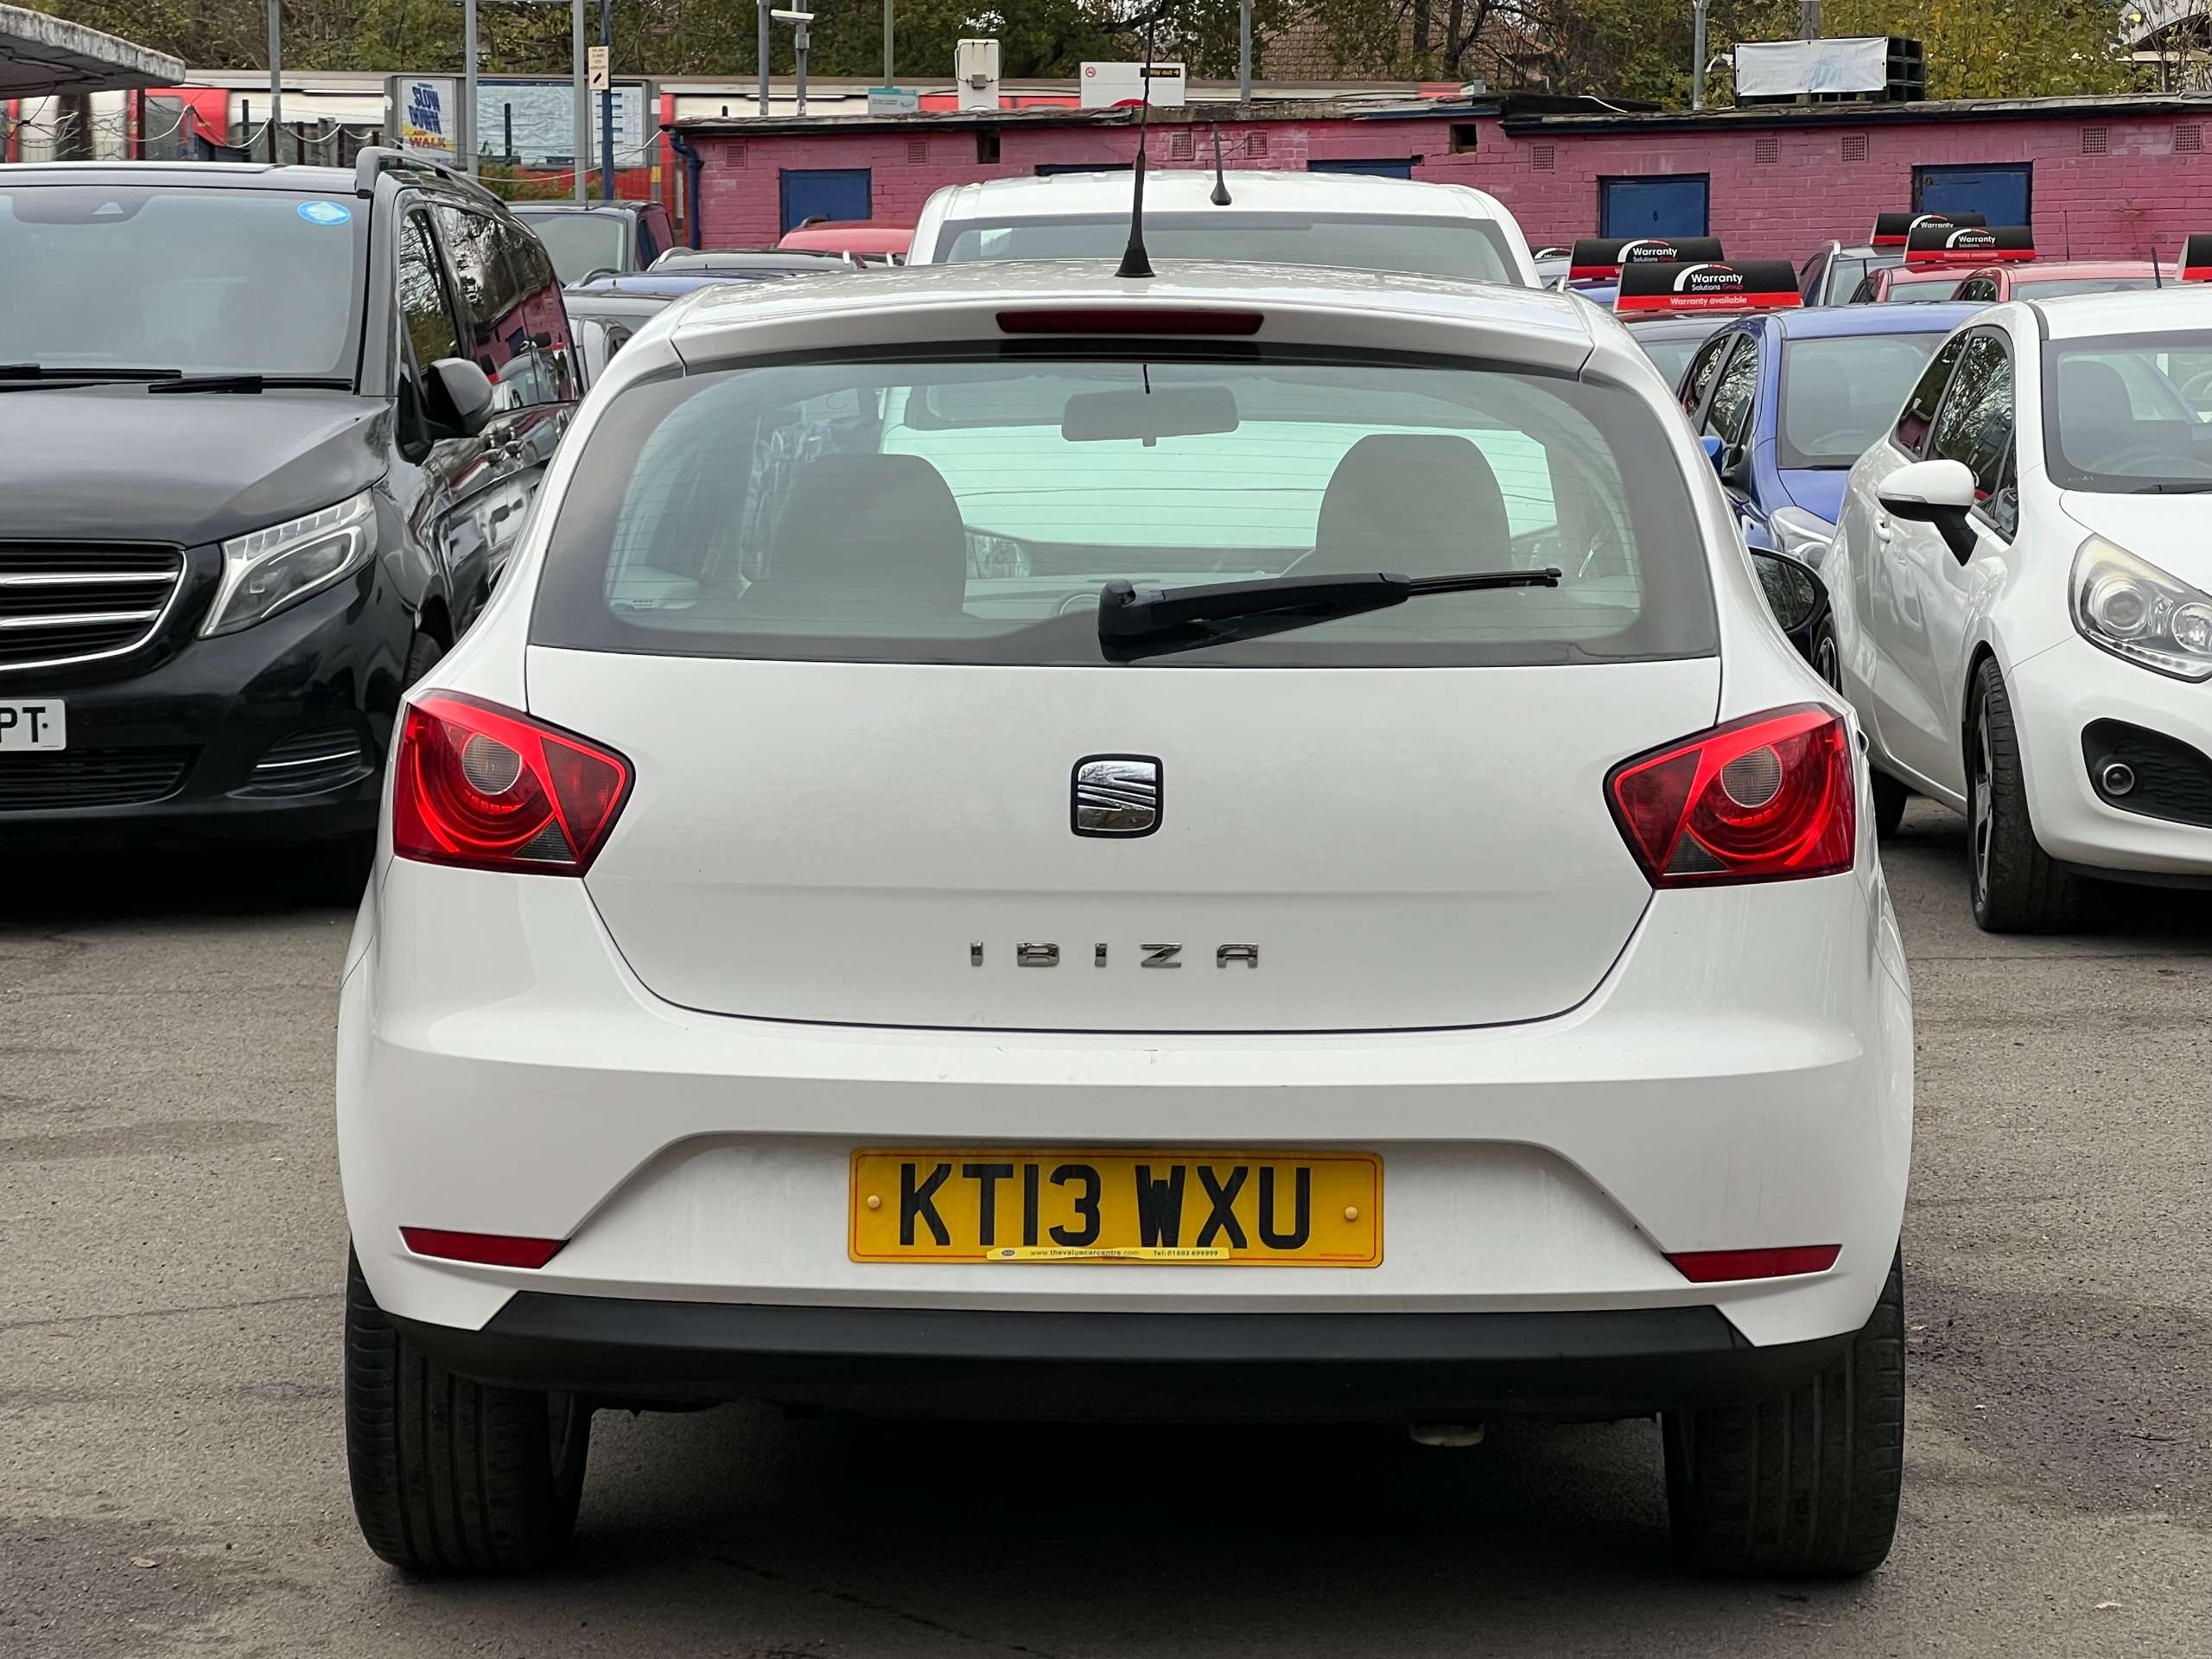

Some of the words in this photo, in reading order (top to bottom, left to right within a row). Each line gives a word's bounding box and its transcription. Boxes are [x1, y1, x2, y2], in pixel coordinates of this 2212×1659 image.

[412, 86, 441, 111] SLOW
[408, 105, 442, 135] DOWN
[410, 137, 446, 149] WALK
[1653, 210, 1659, 222] 6
[1958, 236, 1996, 245] Warranty
[1632, 247, 1678, 257] Warranty
[1691, 273, 1743, 284] Warranty
[1670, 297, 1708, 306] Warranty
[1709, 296, 1747, 304] available
[969, 941, 1259, 969] IBIZA
[899, 1162, 1102, 1248] KT13
[1135, 1165, 1313, 1250] WXU
